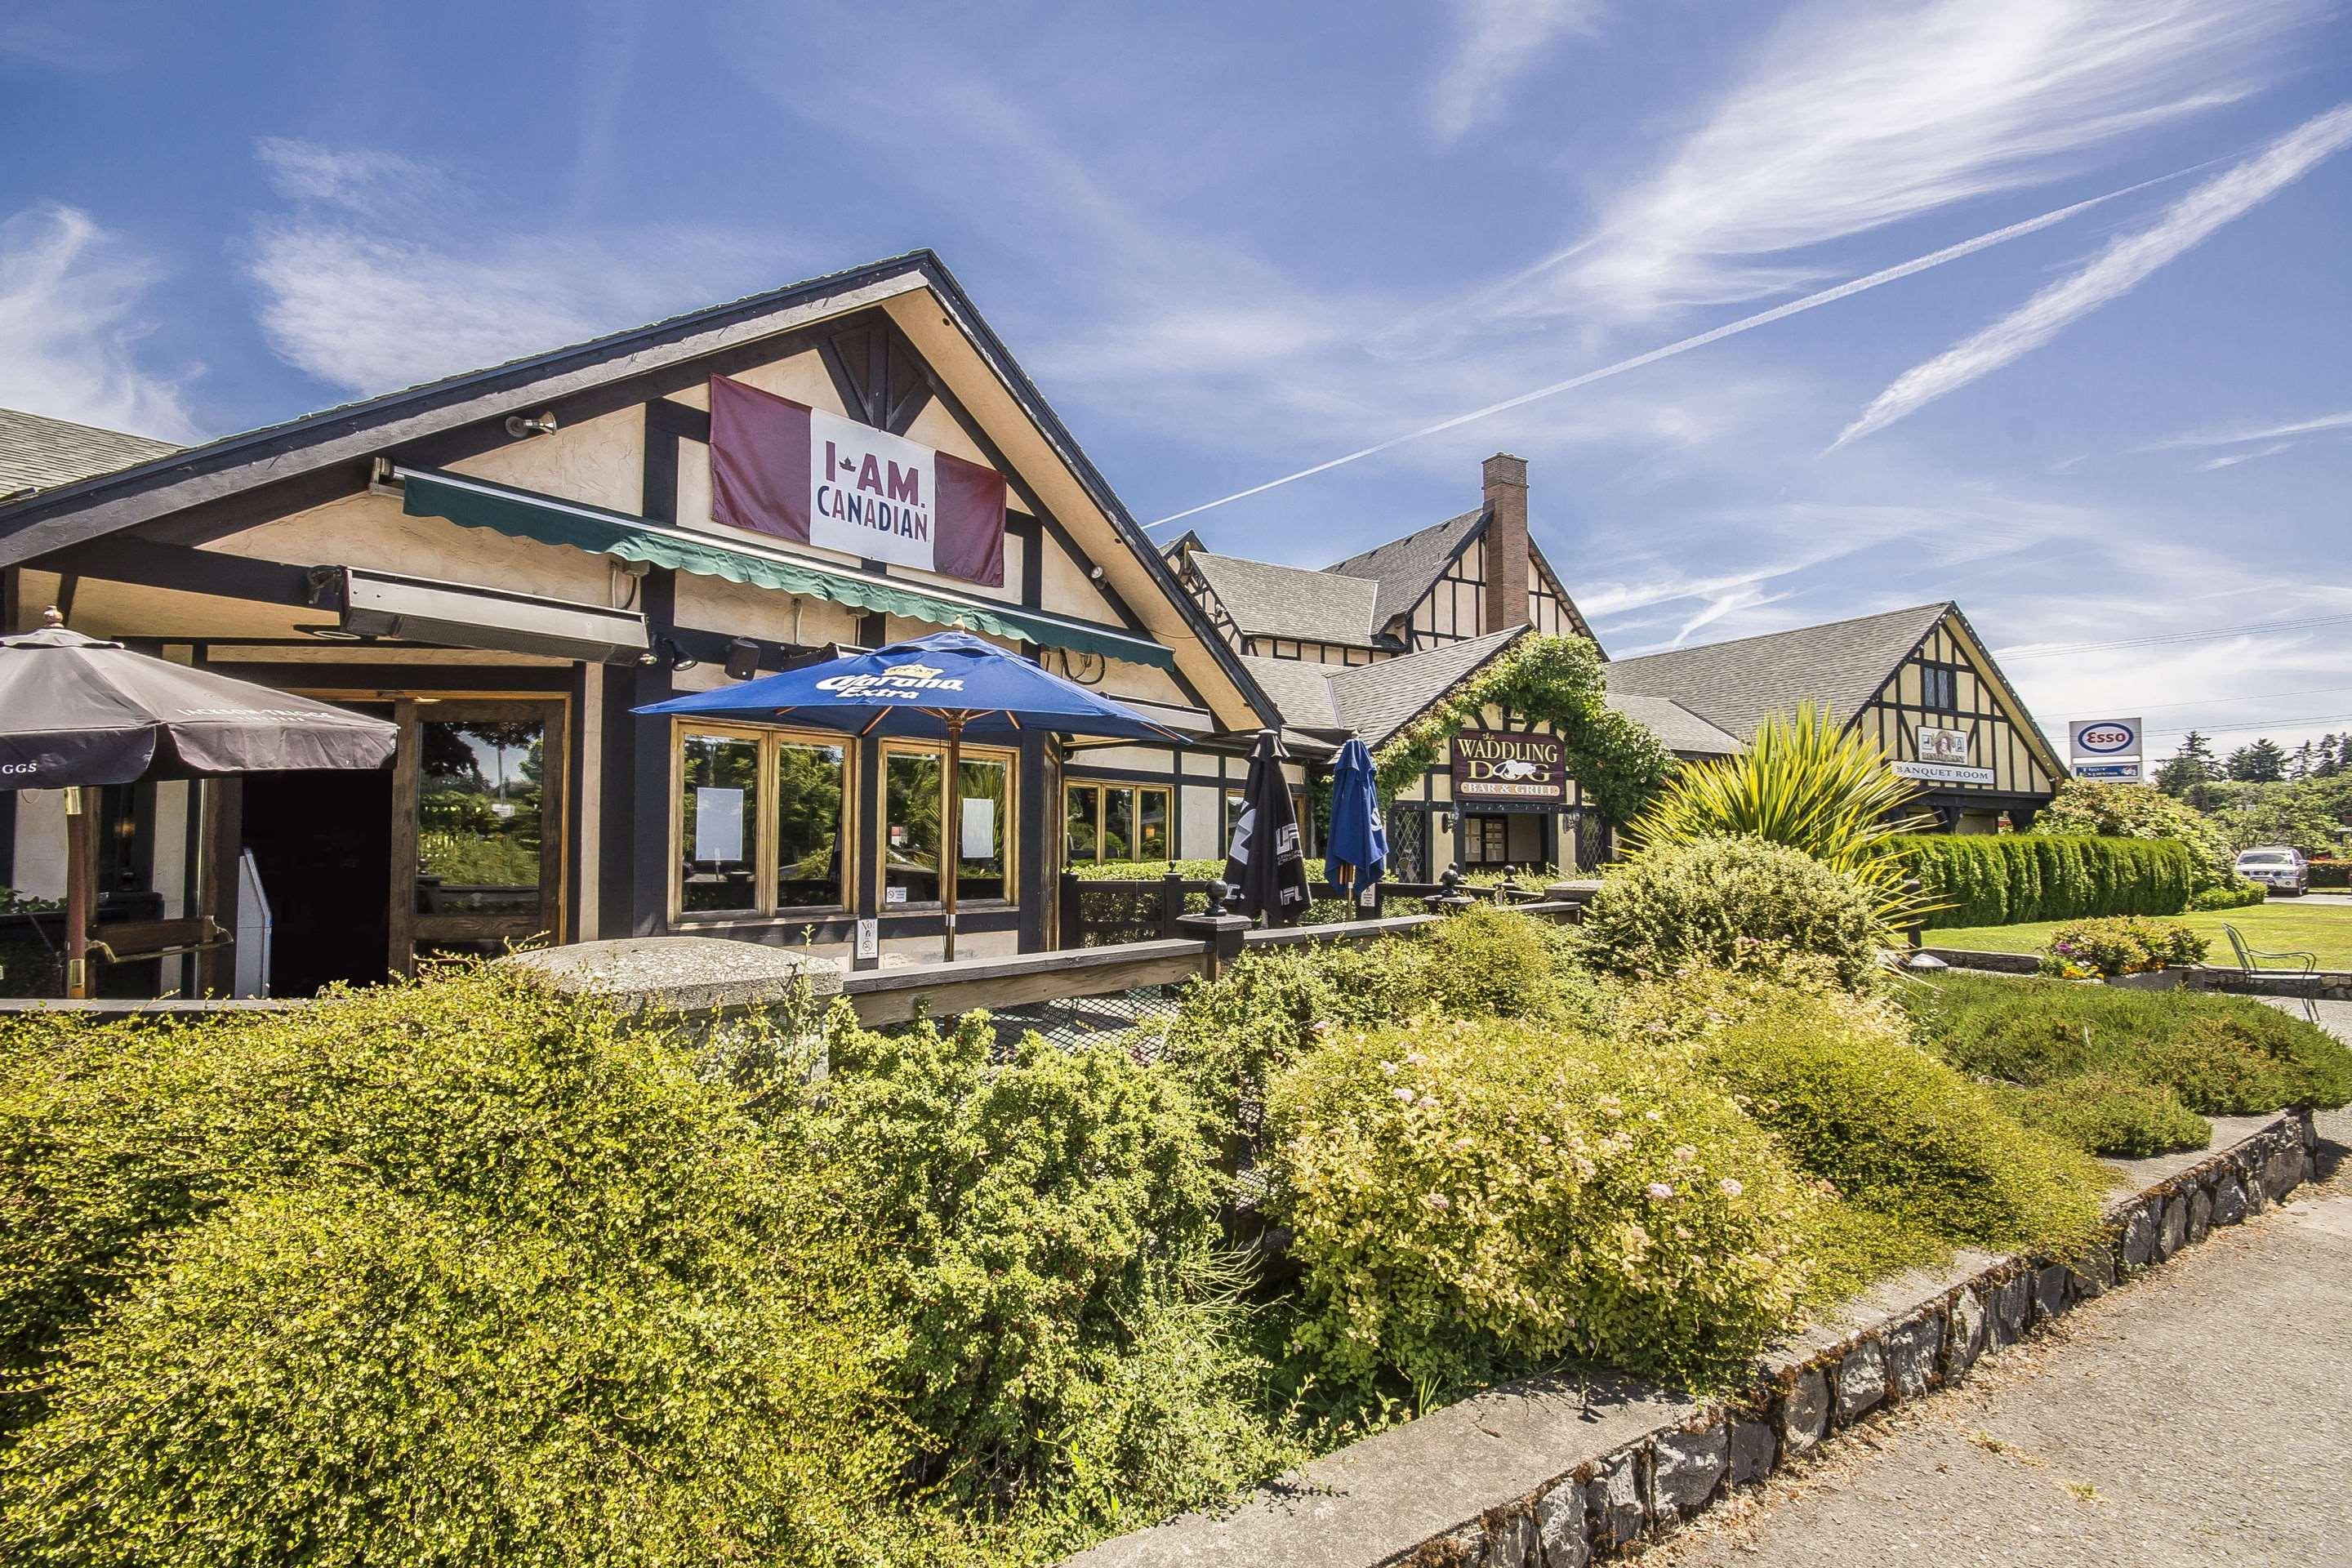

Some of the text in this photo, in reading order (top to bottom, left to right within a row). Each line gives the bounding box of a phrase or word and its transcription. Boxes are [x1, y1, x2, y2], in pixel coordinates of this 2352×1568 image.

[826, 441, 927, 508] I AM.
[817, 485, 928, 542] CANADIAN
[816, 674, 964, 691] Corona
[835, 687, 919, 699] Extra
[2087, 732, 2126, 744] Esso
[1457, 738, 1558, 763] WADDLING
[1896, 765, 1989, 780] BANQUET ROOM
[1468, 783, 1554, 796] BAR & GRILL
